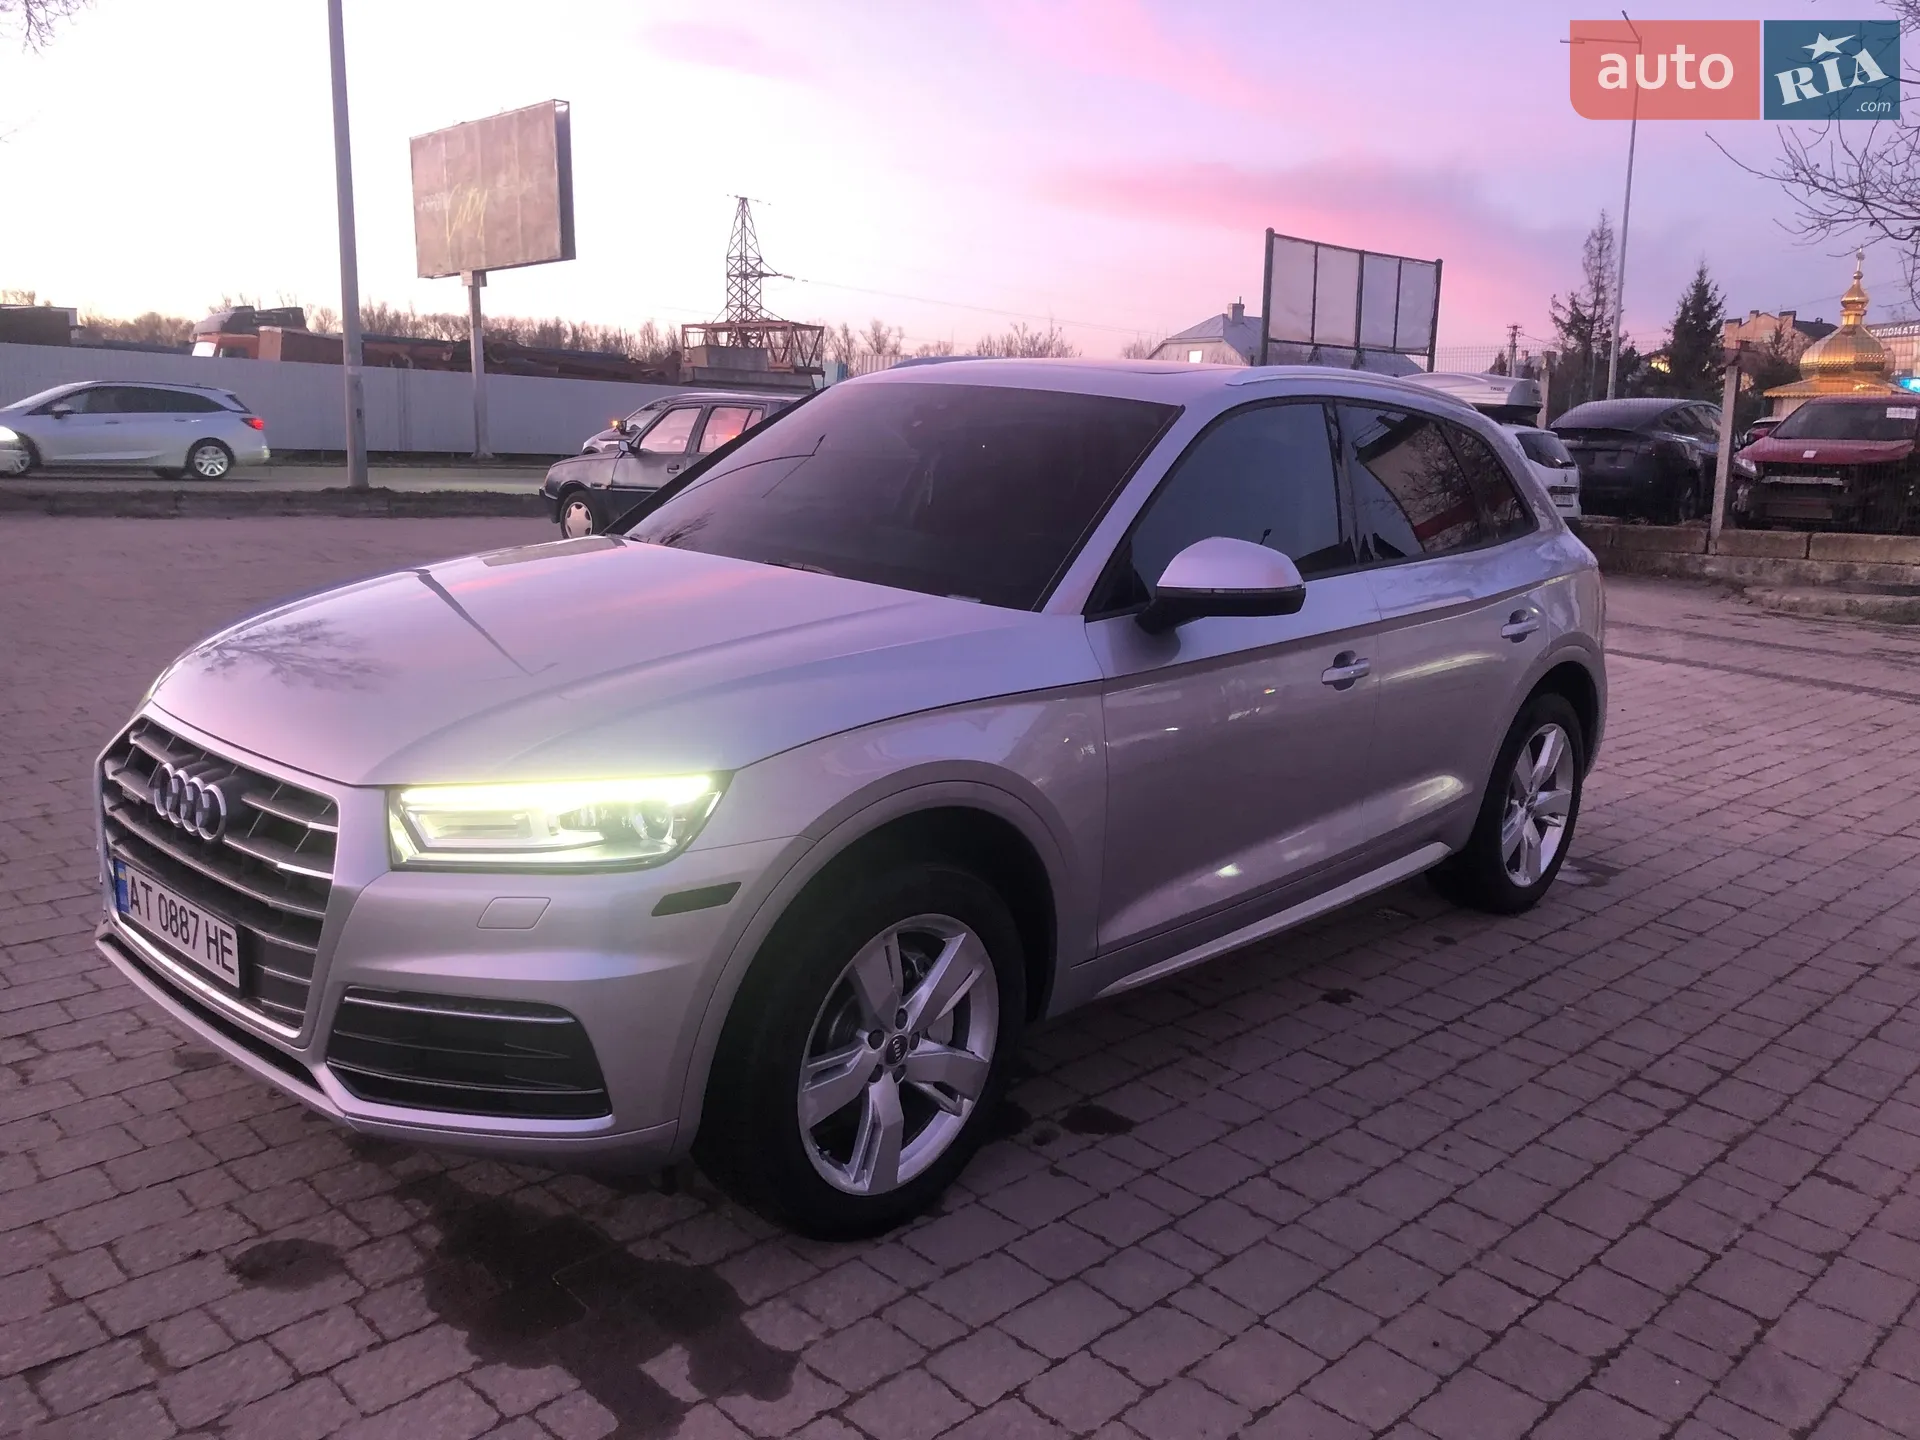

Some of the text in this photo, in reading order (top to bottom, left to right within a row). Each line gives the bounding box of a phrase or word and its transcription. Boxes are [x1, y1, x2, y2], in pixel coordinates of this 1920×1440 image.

[130, 876, 235, 975] AT 0887 HE
